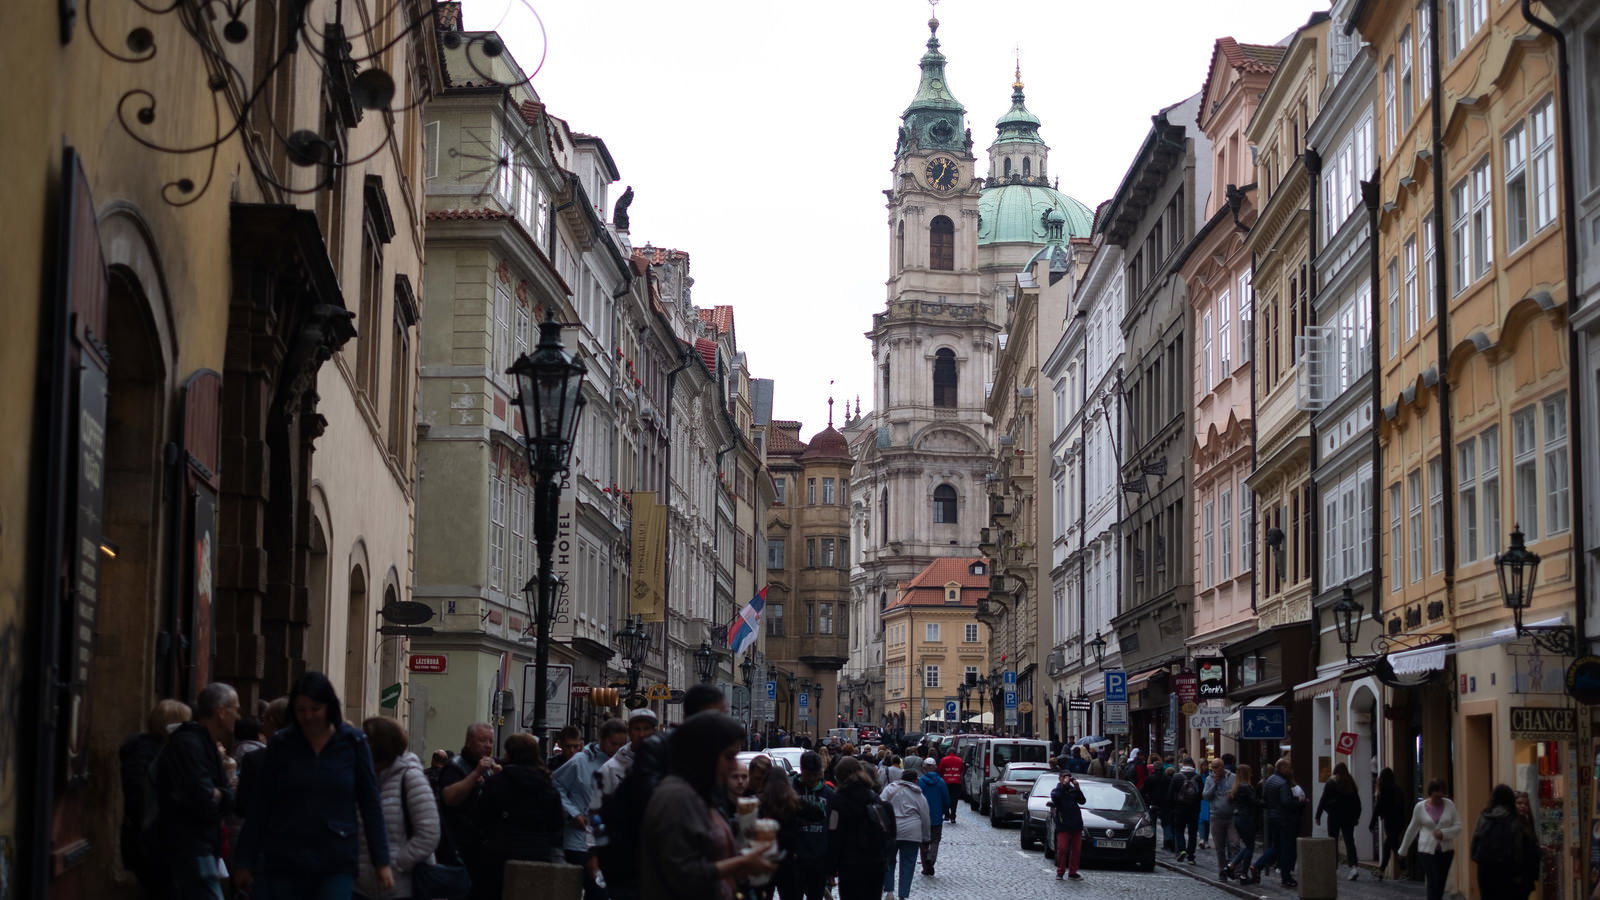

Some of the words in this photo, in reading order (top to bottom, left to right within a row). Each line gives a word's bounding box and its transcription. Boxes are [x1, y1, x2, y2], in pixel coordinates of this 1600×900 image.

[558, 513, 570, 564] HOTEL
[558, 571, 570, 624] DESIGN
[1511, 708, 1574, 731] CHANGE
